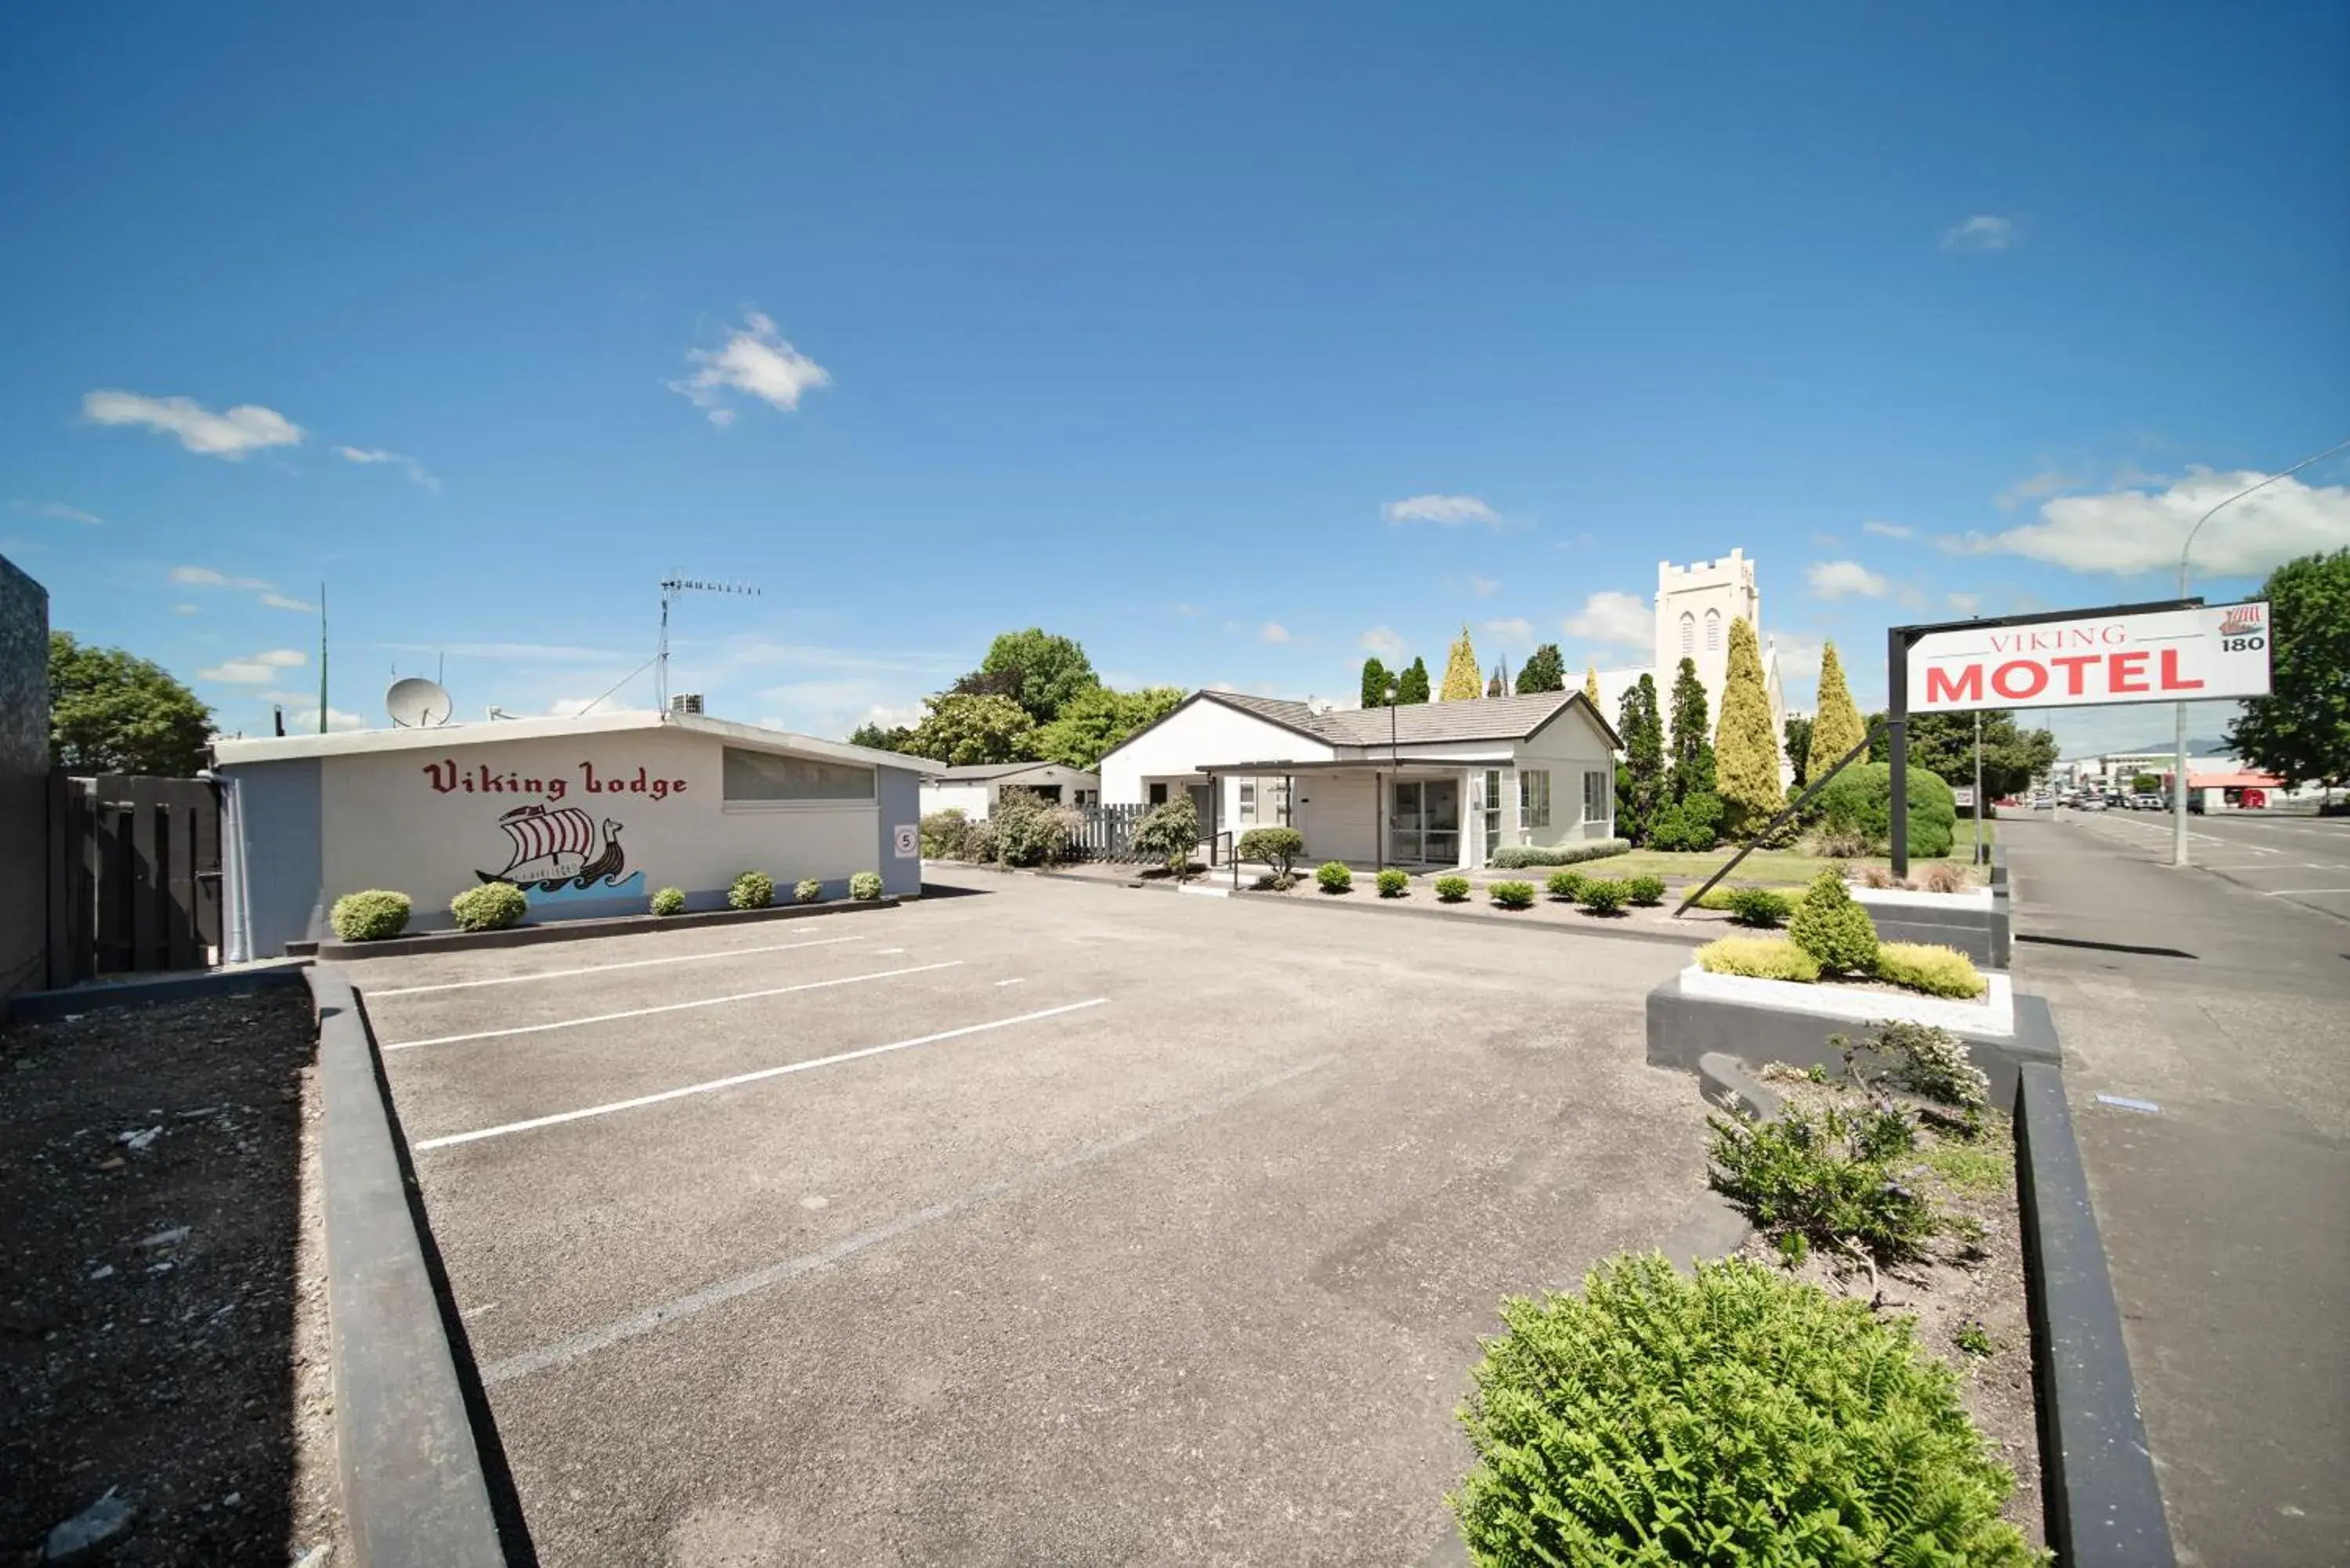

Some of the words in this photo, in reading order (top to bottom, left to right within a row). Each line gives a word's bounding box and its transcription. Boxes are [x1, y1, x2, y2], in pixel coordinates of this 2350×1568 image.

[1990, 623, 2129, 652] VIKING
[2222, 637, 2265, 652] 180
[1926, 649, 2204, 703] MOTEL
[423, 758, 568, 801] Viking
[579, 761, 687, 800] Lodge
[902, 834, 911, 847] 5
